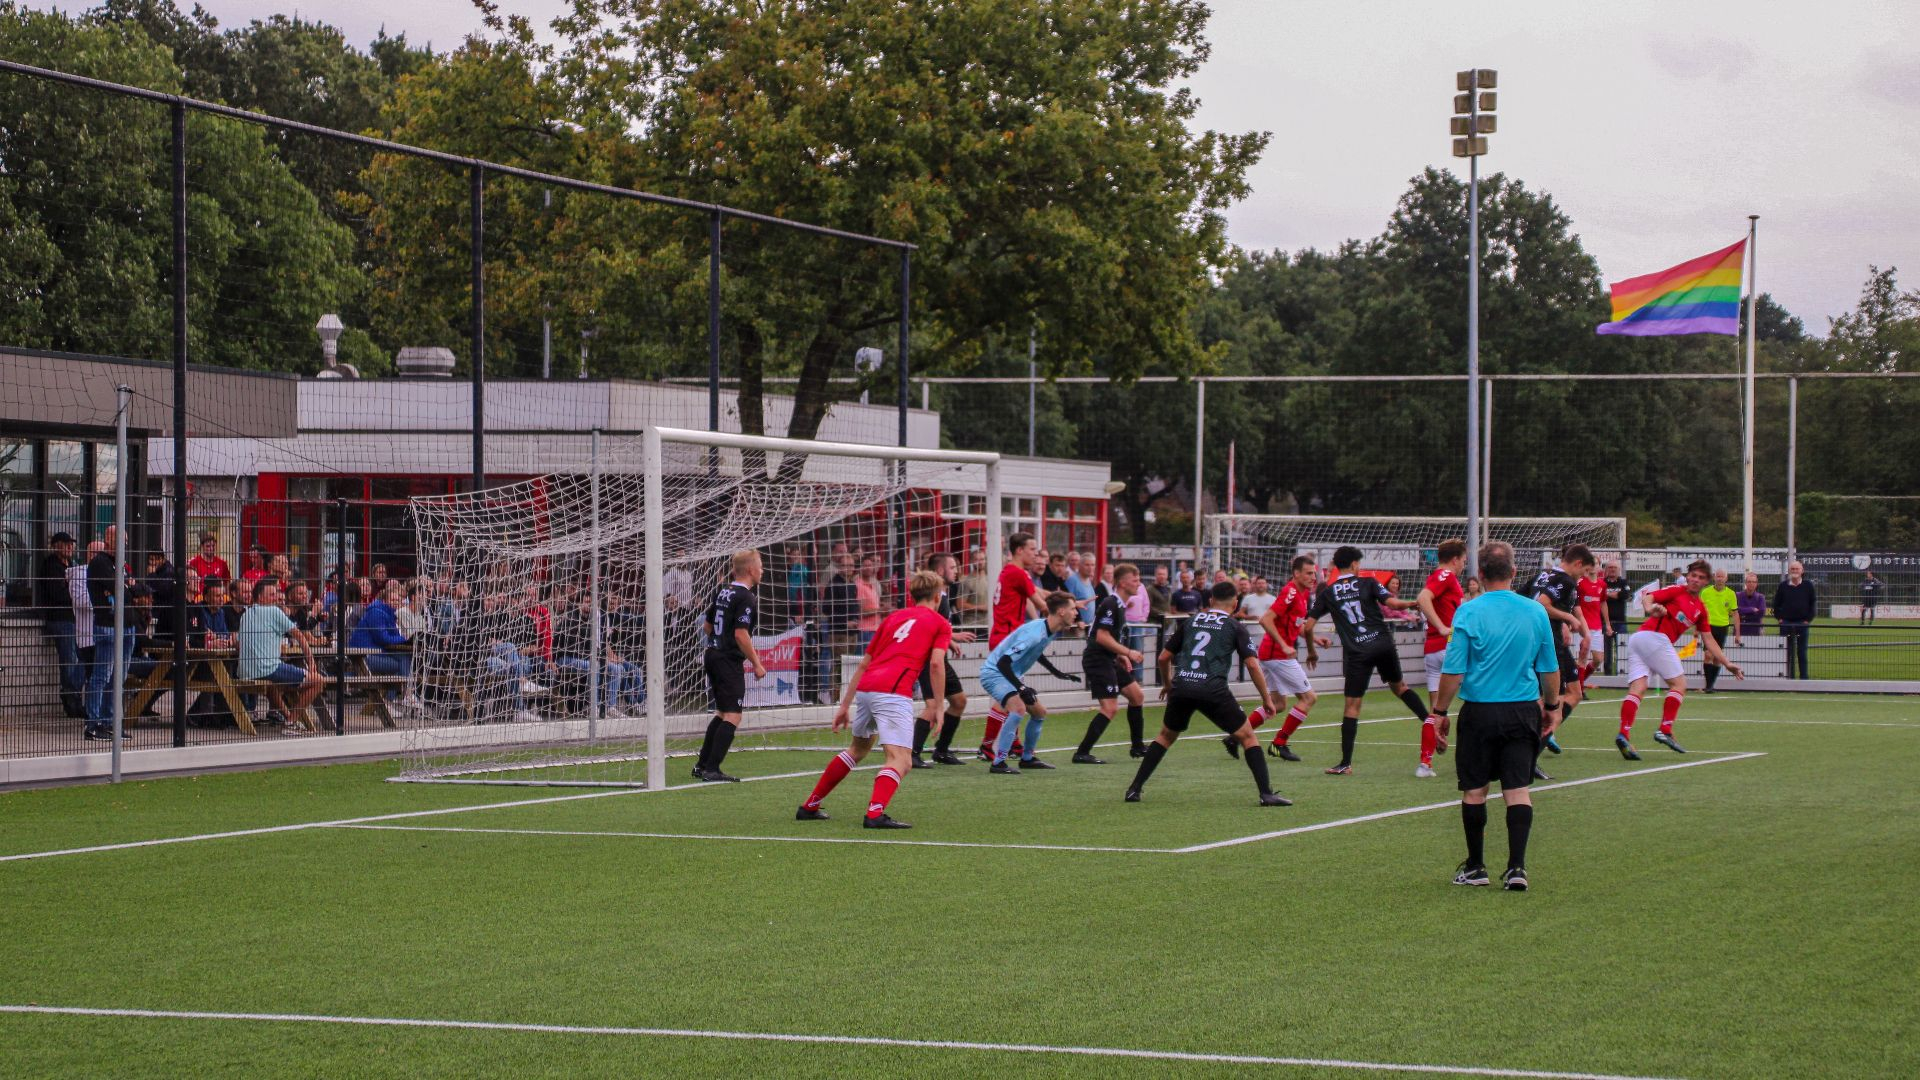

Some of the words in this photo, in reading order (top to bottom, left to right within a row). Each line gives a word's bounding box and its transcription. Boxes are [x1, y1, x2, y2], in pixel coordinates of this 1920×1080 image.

[1803, 557, 1850, 565] FLETCHER
[1333, 580, 1360, 595] PPC
[1193, 612, 1228, 625] PPC
[1342, 600, 1365, 624] 17
[714, 609, 724, 635] 5
[892, 618, 917, 643] 4
[1191, 631, 1211, 656] 2
[1179, 668, 1208, 680] fortune
